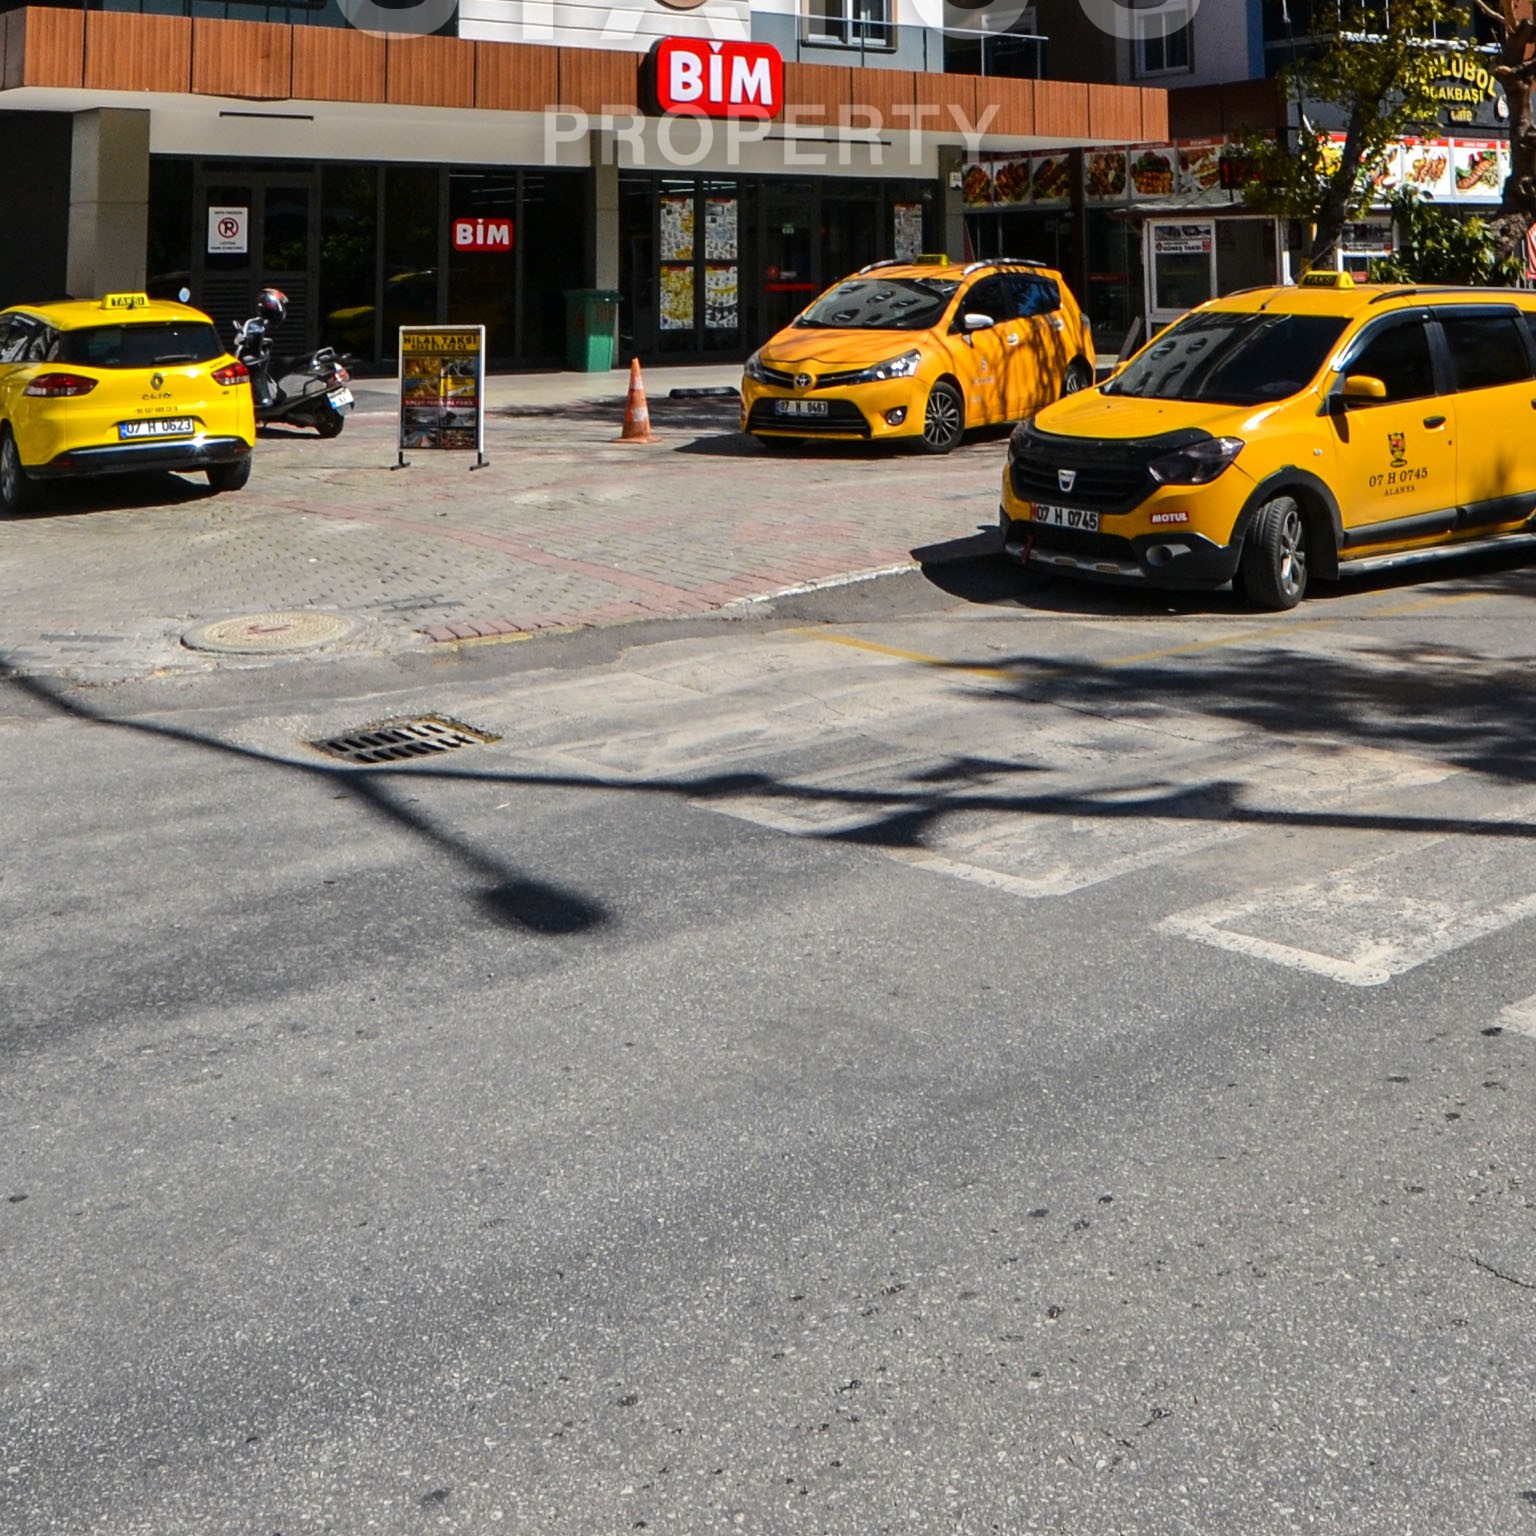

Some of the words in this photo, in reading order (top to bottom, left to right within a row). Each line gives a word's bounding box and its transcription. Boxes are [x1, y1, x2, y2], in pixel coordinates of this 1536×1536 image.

[670, 40, 773, 106] BİM
[456, 218, 510, 245] BİM
[126, 421, 140, 434] 07
[148, 420, 157, 433] H
[1369, 474, 1383, 488] 07
[1388, 471, 1396, 484] H
[1400, 467, 1428, 482] 0745
[1384, 484, 1415, 496] ALANYA
[1036, 506, 1049, 520] 07
[1055, 508, 1063, 525] H
[1068, 510, 1097, 529] 0745
[1152, 512, 1188, 524] MOTUL
